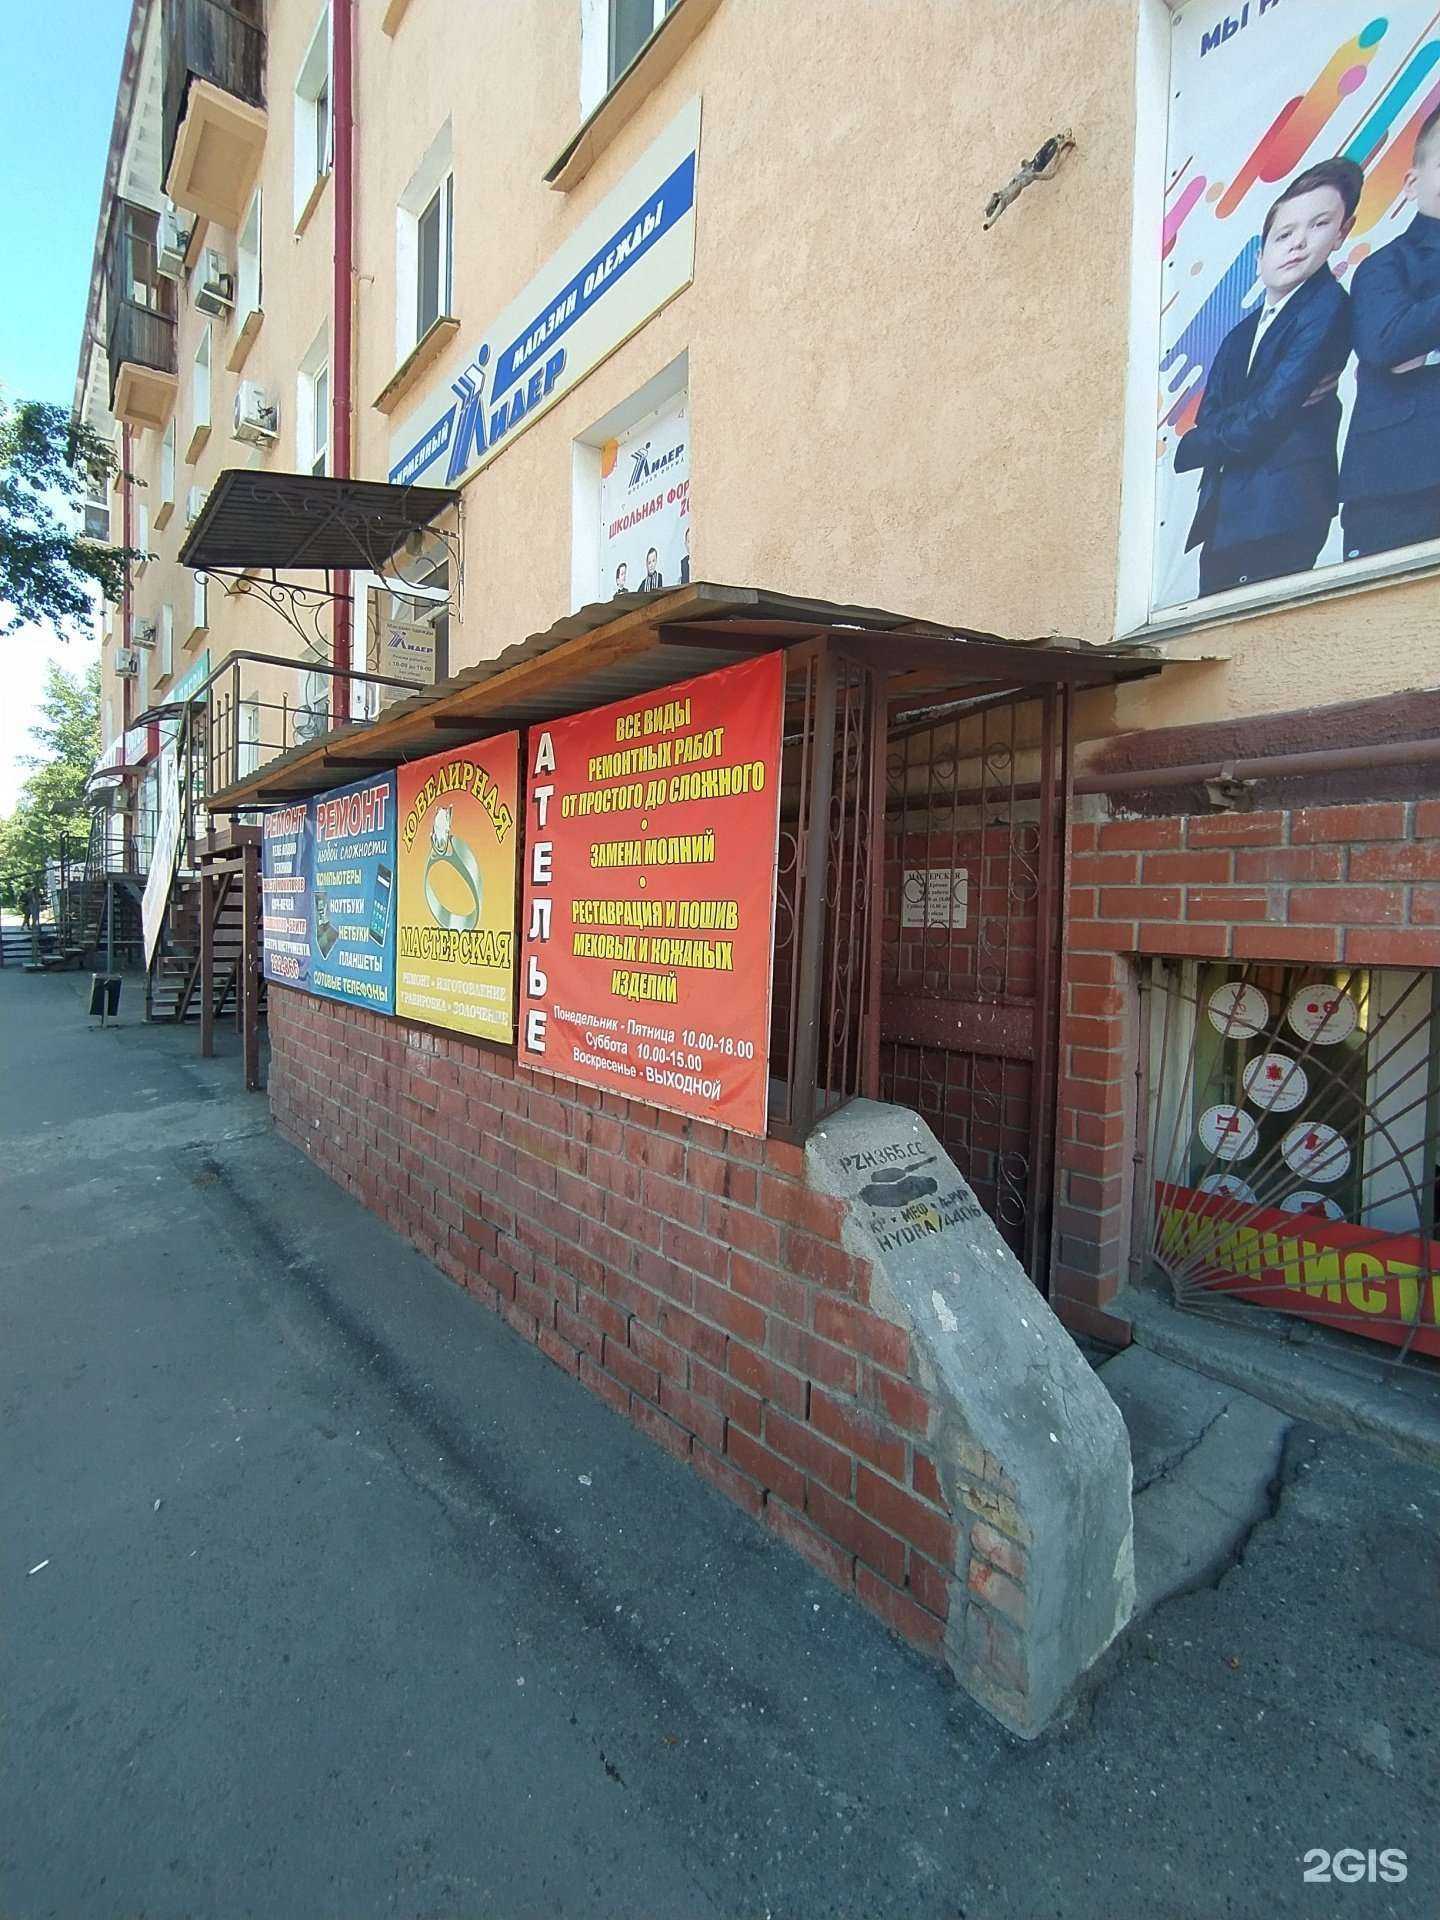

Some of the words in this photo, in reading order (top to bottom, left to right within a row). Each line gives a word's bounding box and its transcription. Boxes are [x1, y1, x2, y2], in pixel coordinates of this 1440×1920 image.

[1200, 2, 1249, 57] МЫ
[512, 290, 578, 372] МАГАЗИН
[583, 199, 664, 301] ОДЕЖДЫ
[608, 494, 664, 540] ШКОЛЬНАЯ
[616, 712, 641, 742] ВСЕ
[643, 698, 691, 735] ВИДЫ
[588, 742, 673, 782] РЕМОНТНЫХ
[674, 727, 725, 766] РАБОТ
[402, 760, 513, 854] ЮВЕЛИРНАЯ
[561, 793, 577, 818] ОТ
[578, 783, 643, 816] ПРОСТОГО
[645, 779, 666, 811] ДО
[669, 761, 765, 803] СЛОЖНОГО
[264, 804, 307, 839] РЕМОНТ
[316, 783, 389, 842] РЕМОНТ
[590, 840, 642, 868] ЗАМЕНА
[644, 829, 715, 866] МОЛНИЙ
[316, 869, 362, 886] КОМПЬЮТЕРЫ
[330, 898, 365, 914] НОУТБУКИ
[572, 900, 663, 931] РЕСТАВРАЦИЯ
[664, 901, 676, 928] И
[679, 901, 739, 931] ПОШИВ
[339, 926, 369, 942] НЕТБУКИ
[400, 926, 512, 969] МАСТЕРСКАЯ
[573, 932, 637, 962] МЕХОВЫХ
[638, 936, 649, 963] И
[650, 937, 734, 971] КОЖАНЫХ
[339, 951, 382, 972] ПЛАНШЕТЫ
[313, 971, 342, 991] СОТОВЫЕ
[342, 978, 388, 1002] ТЕЛЕФОНЫ
[611, 969, 679, 1003] ИЗДЕЛИЙ
[553, 1005, 618, 1031] Понедельник
[626, 1019, 675, 1045] Пятница
[682, 1029, 754, 1060] 10.00-18.00
[585, 1031, 628, 1056] Суббота
[636, 1043, 702, 1072] 10.00-15.00
[573, 1047, 637, 1078] Воскресенье
[646, 1066, 722, 1100] ВЫХОДНОЙ
[876, 1204, 982, 1253] HYDRA/4406
